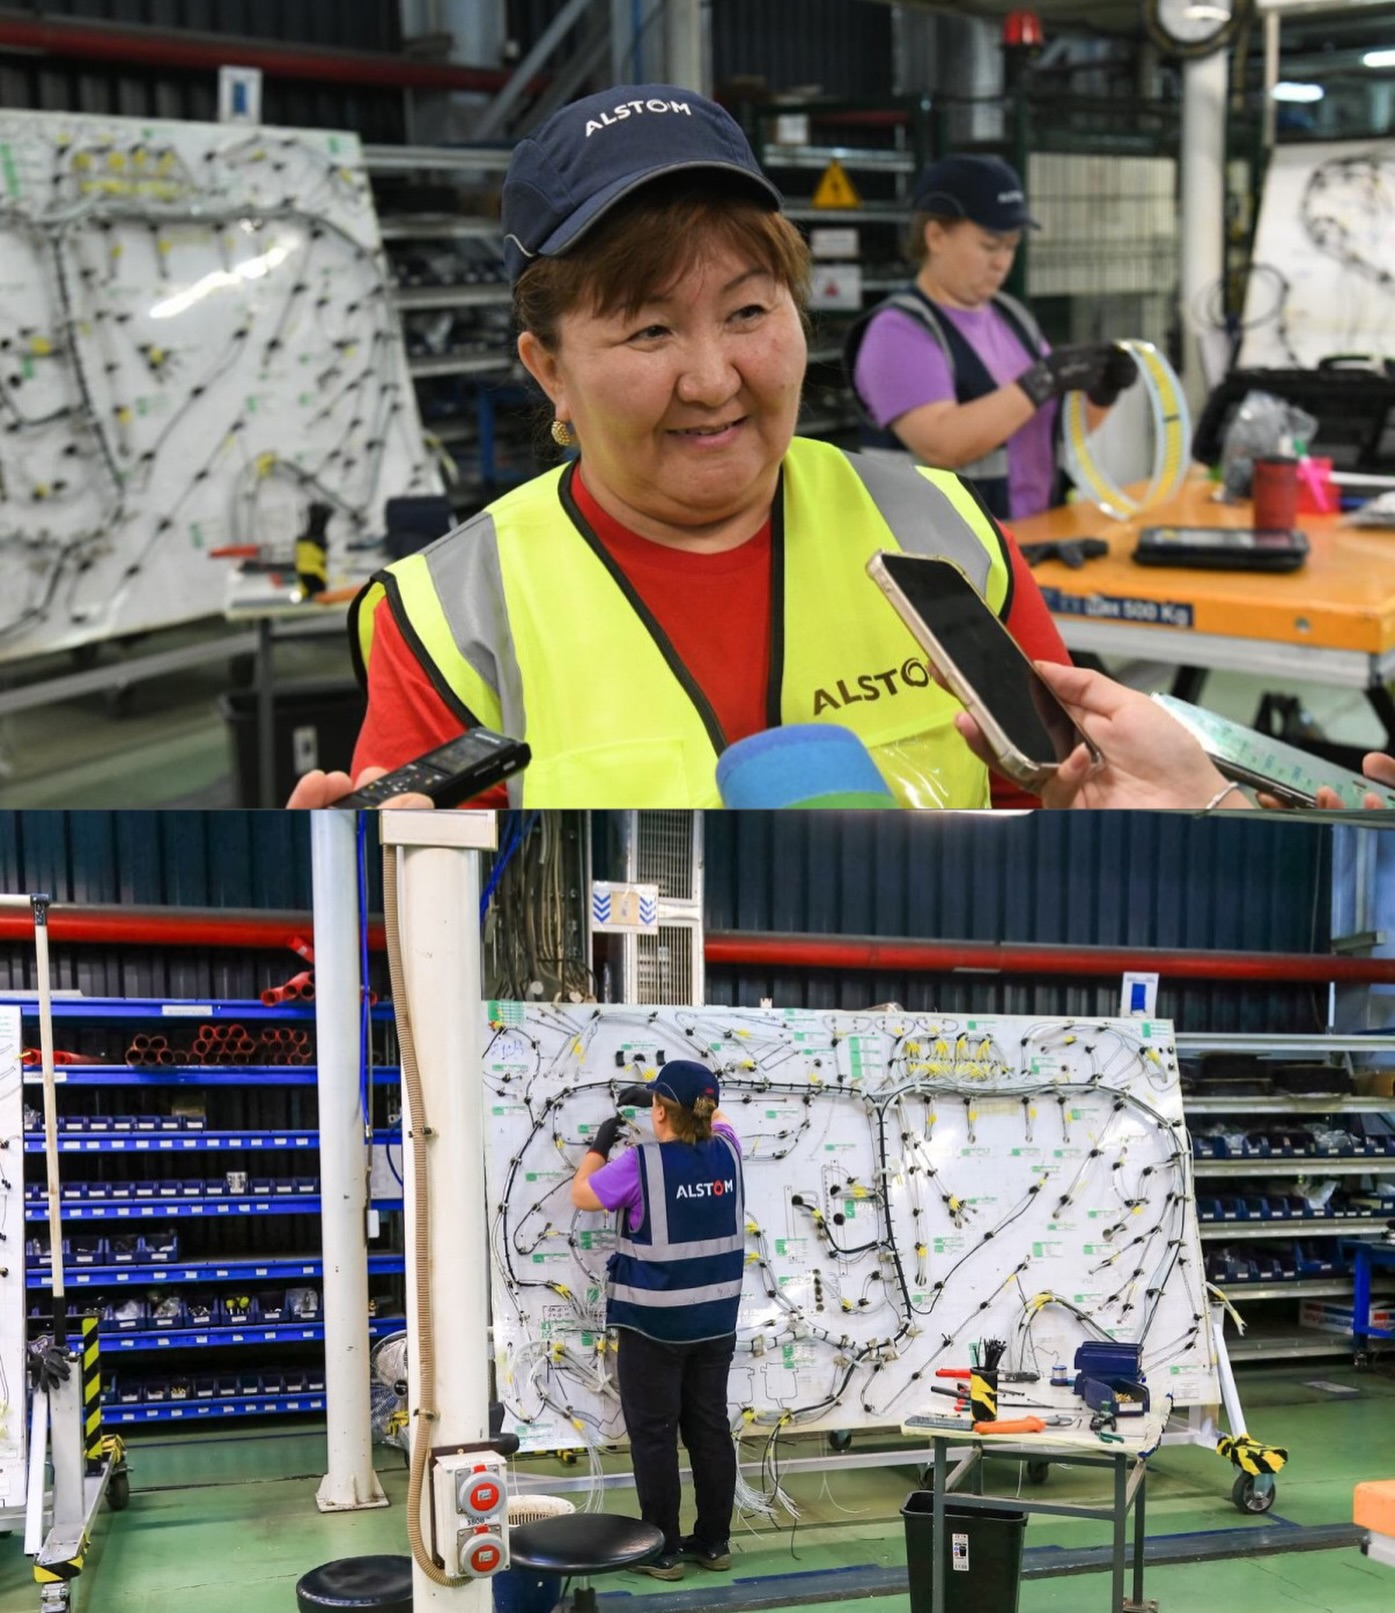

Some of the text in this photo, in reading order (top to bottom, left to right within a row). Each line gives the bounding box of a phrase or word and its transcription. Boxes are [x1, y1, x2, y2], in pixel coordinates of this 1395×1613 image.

[585, 99, 692, 137] ALSTOM
[813, 657, 930, 716] ALSTO
[676, 1179, 733, 1199] ALSTOM
